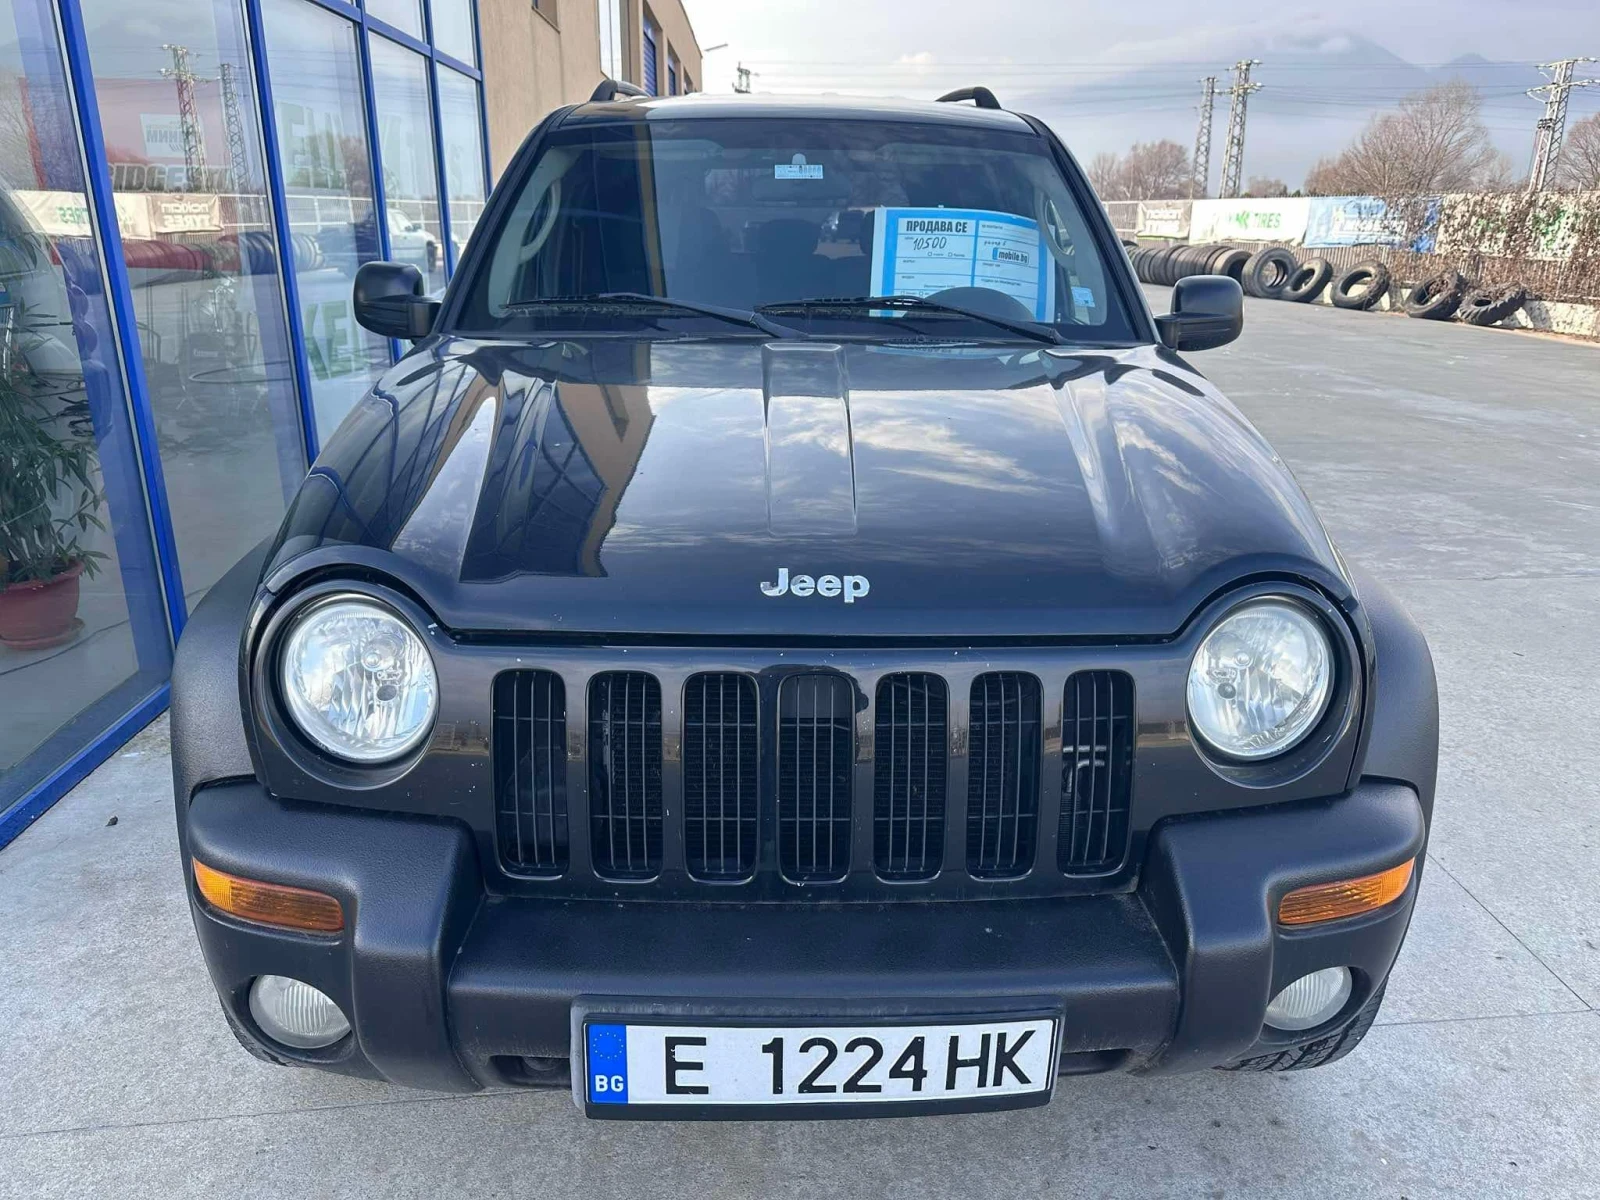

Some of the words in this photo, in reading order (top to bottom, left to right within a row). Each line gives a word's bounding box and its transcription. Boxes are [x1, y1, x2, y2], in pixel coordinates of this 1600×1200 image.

[906, 220, 953, 233] ПРОДАВА
[955, 221, 968, 233] СЕ
[913, 236, 947, 251] 10500
[998, 250, 1028, 264] mobile.bg
[760, 567, 870, 603] Jeep
[665, 1036, 709, 1094] E
[762, 1036, 927, 1094] 1224
[946, 1030, 1036, 1090] HK
[595, 1074, 624, 1092] BG
